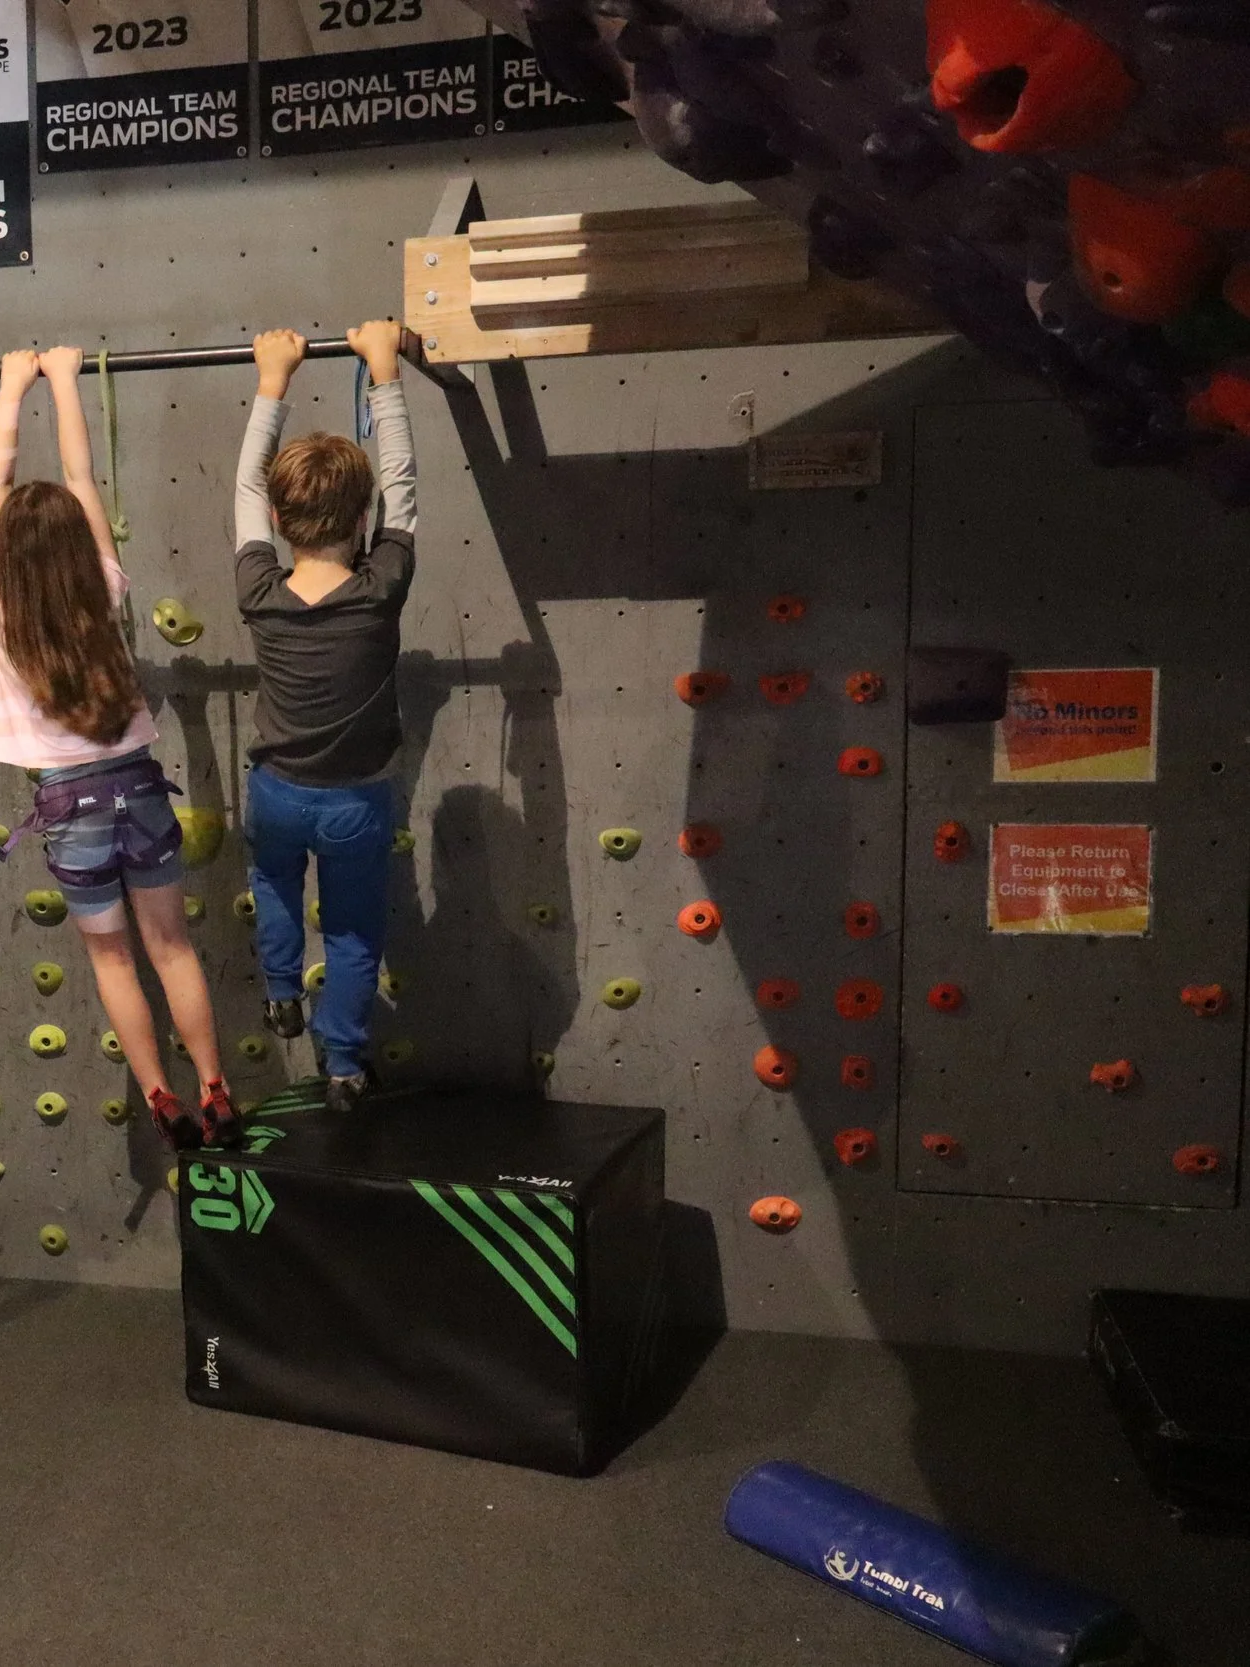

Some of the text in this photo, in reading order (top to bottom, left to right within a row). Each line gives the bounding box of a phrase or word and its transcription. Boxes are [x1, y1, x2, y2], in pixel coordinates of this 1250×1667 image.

[319, 0, 422, 31] 2023
[92, 16, 188, 54] 2023
[271, 64, 476, 105] REGIONAL TEAM
[503, 57, 542, 79] RE
[46, 89, 237, 125] REGIONAL TEAM
[271, 88, 477, 133] CHAMPIONS
[46, 113, 239, 152] CHAMPIONS
[1055, 701, 1139, 720] Minors
[1009, 844, 1130, 859] Please Return
[1011, 863, 1105, 880] Equipment
[999, 882, 1058, 897] Close
[1059, 884, 1101, 897] After
[188, 1162, 241, 1232] 30
[202, 1336, 220, 1389] Yes4All
[863, 1560, 910, 1593] Tumbl
